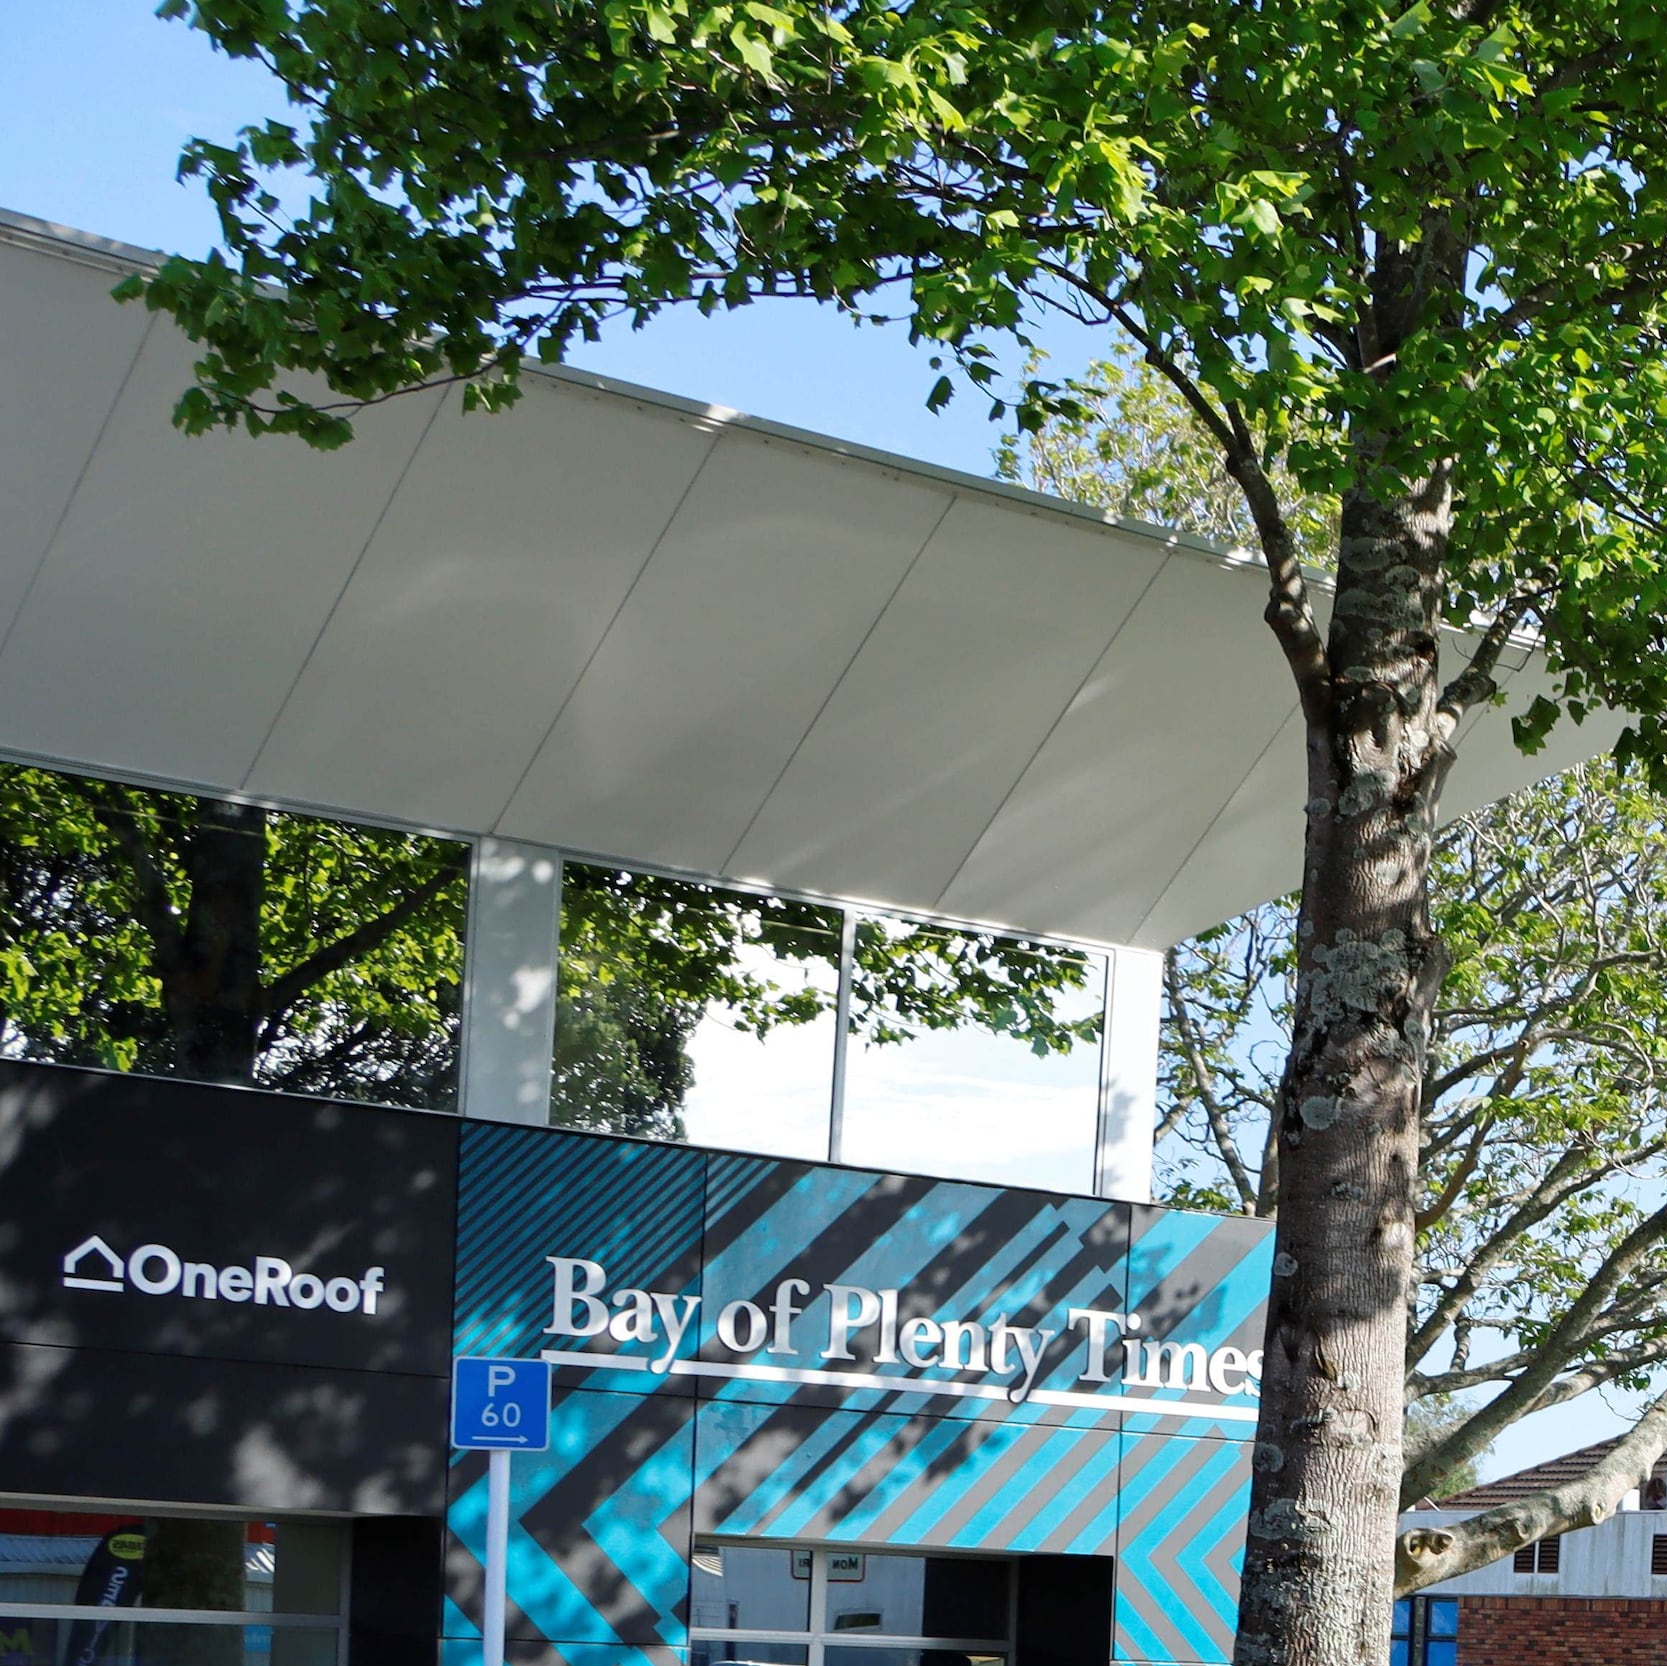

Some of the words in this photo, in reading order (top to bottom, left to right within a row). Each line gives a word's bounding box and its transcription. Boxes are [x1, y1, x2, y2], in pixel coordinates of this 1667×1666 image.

[128, 1244, 385, 1315] OneRoof
[541, 1255, 702, 1374] Bay
[717, 1278, 810, 1355] of
[821, 1282, 1055, 1404] Plenty
[488, 1366, 515, 1398] P
[481, 1403, 522, 1428] 60
